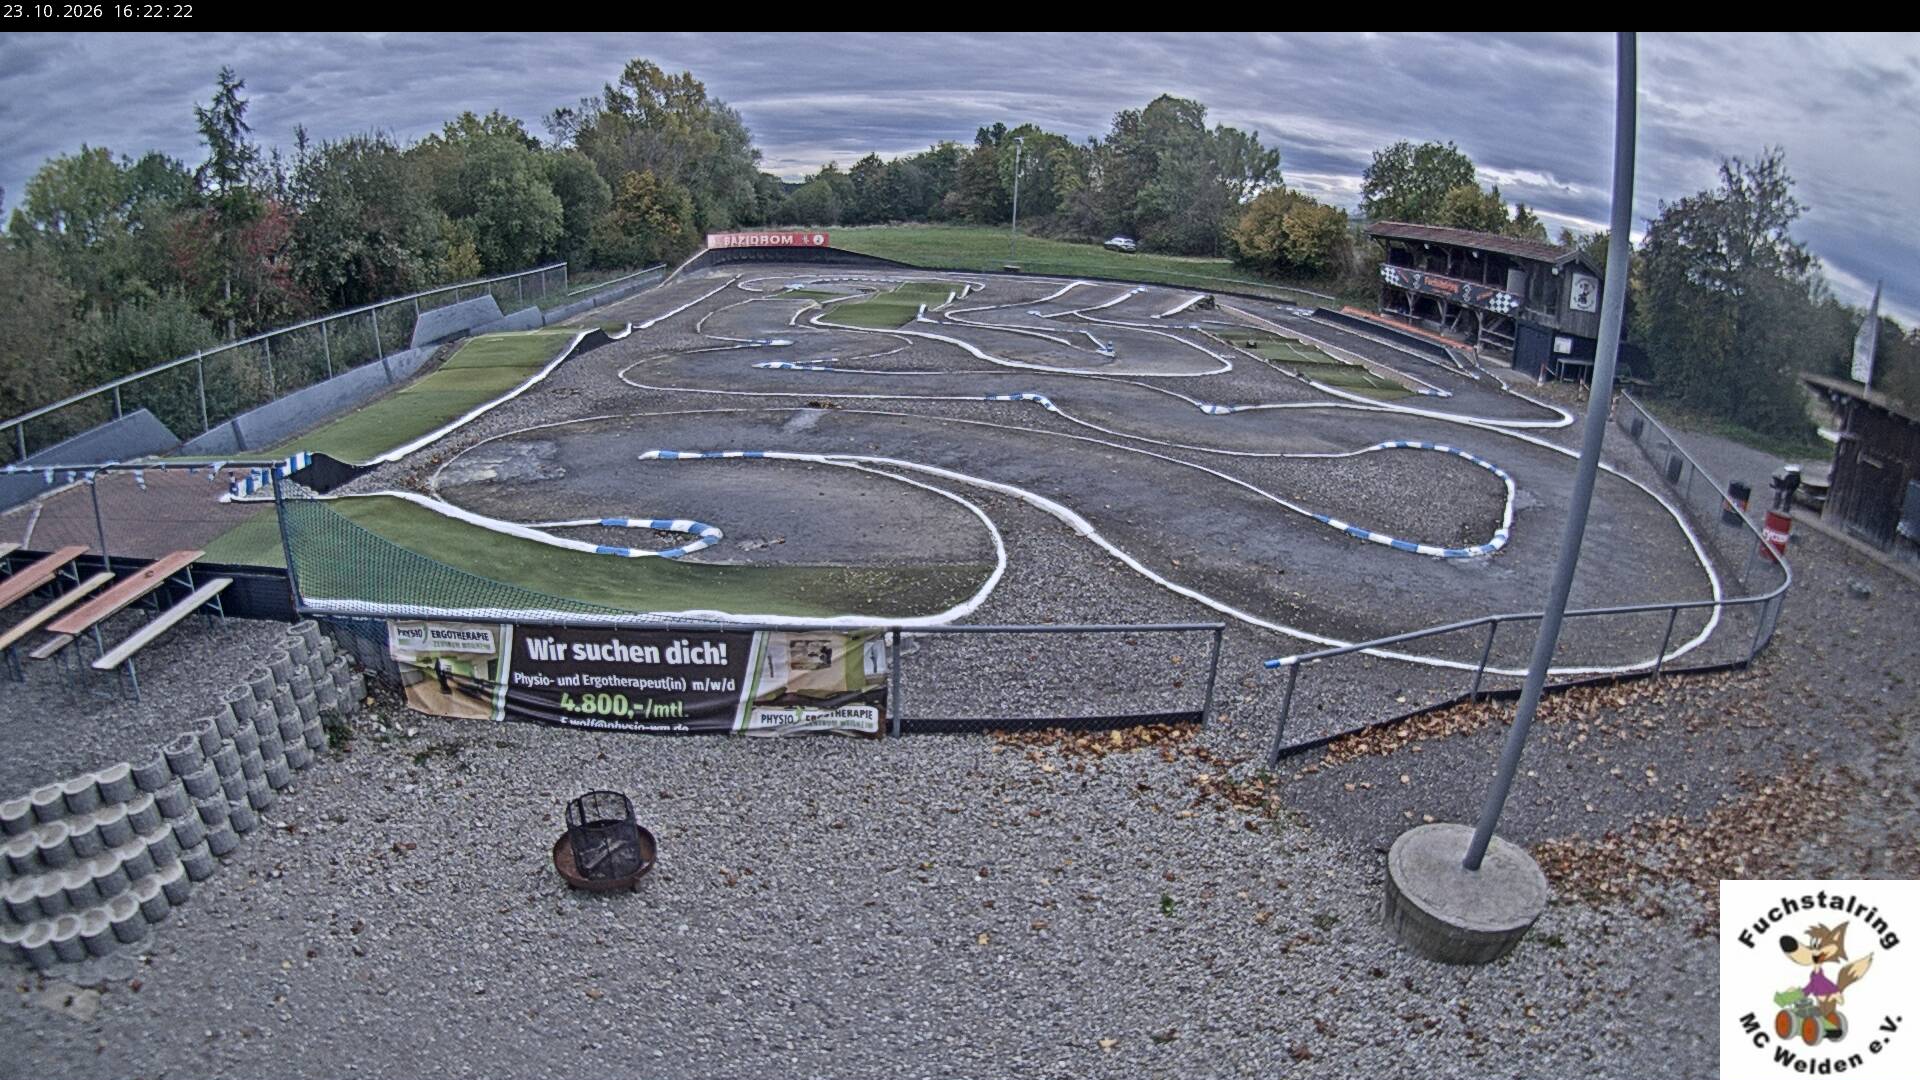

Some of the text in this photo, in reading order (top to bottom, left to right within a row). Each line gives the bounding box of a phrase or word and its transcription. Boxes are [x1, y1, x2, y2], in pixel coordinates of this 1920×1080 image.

[397, 628, 490, 641] PHYSIO ERGOTHERAPIE
[526, 637, 728, 666] Wir suchen dich!
[513, 671, 736, 692] Physio- und Ergotherapeut(in) m/w/d
[560, 692, 689, 719] 4.800,-/mtl.
[761, 713, 794, 725] PHYSIO
